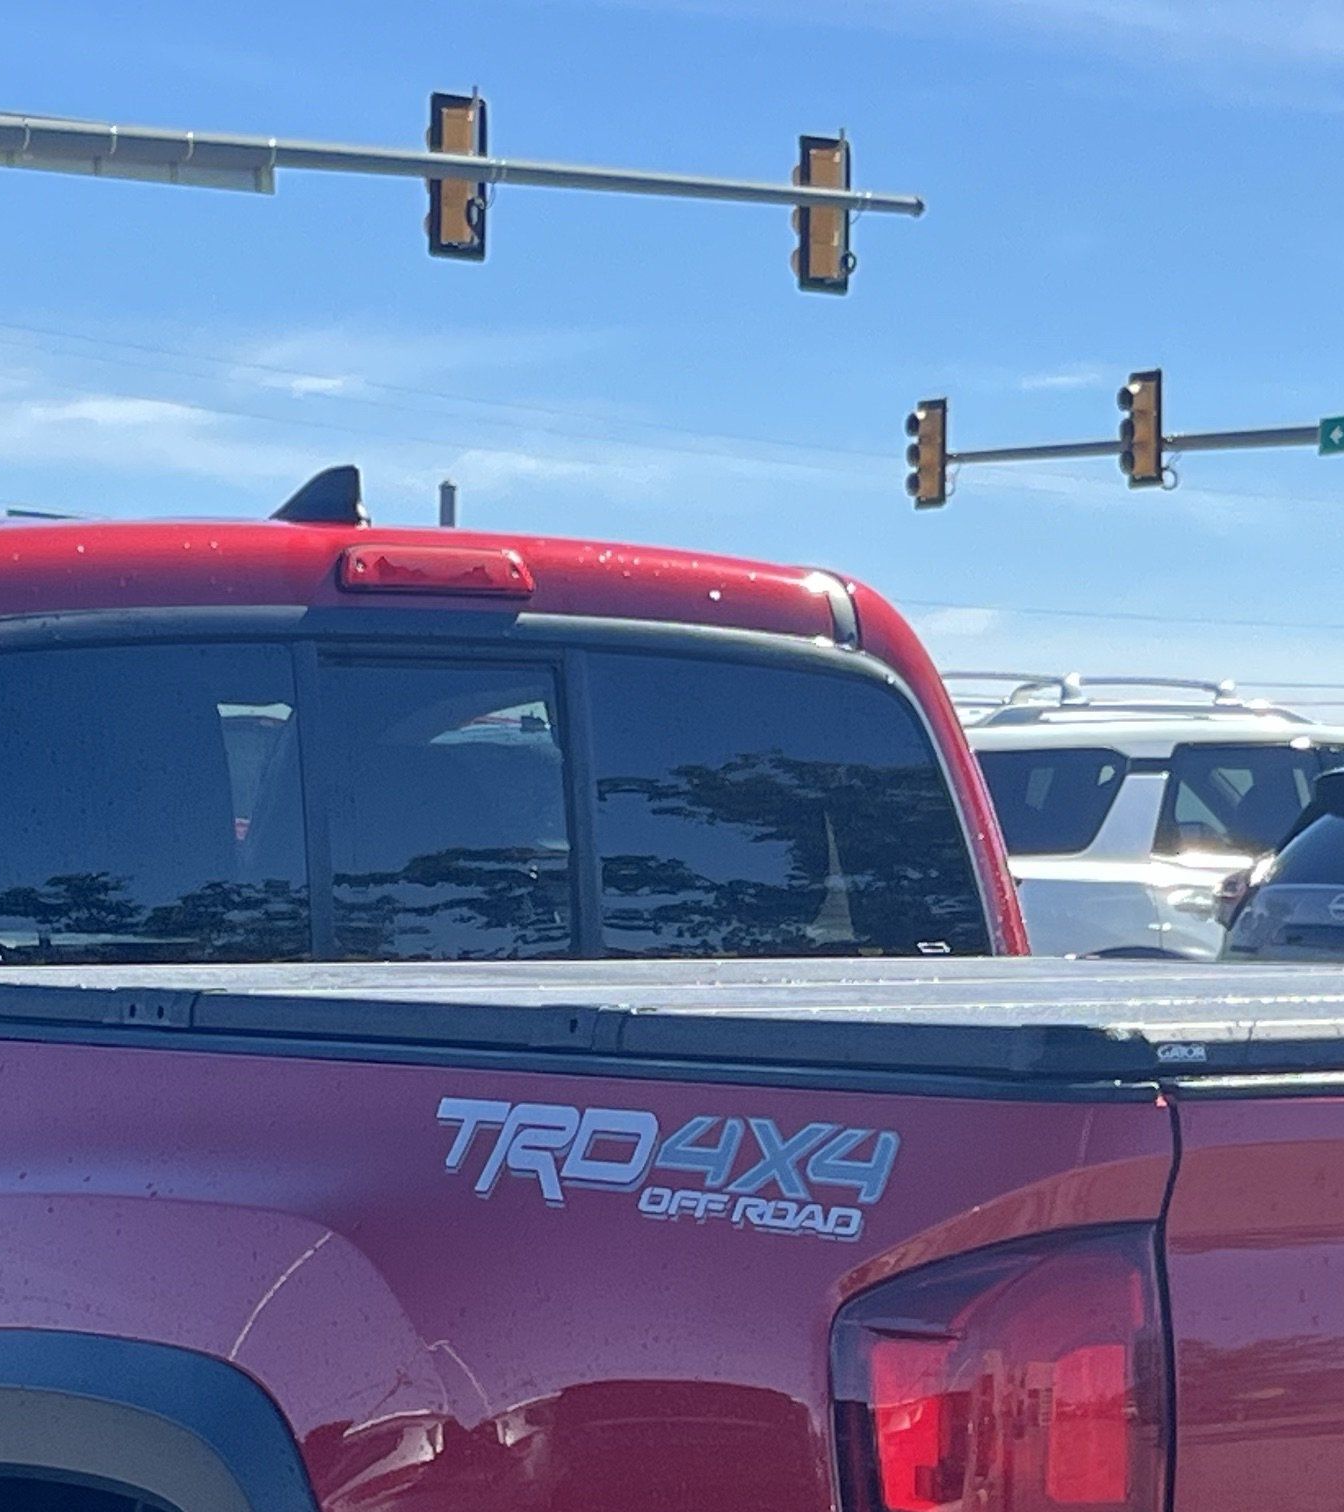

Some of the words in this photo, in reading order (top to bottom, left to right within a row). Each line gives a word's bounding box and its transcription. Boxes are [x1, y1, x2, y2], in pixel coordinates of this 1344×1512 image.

[436, 1097, 658, 1207] TRD
[638, 1187, 730, 1224] OFF
[731, 1196, 864, 1242] ROAD
